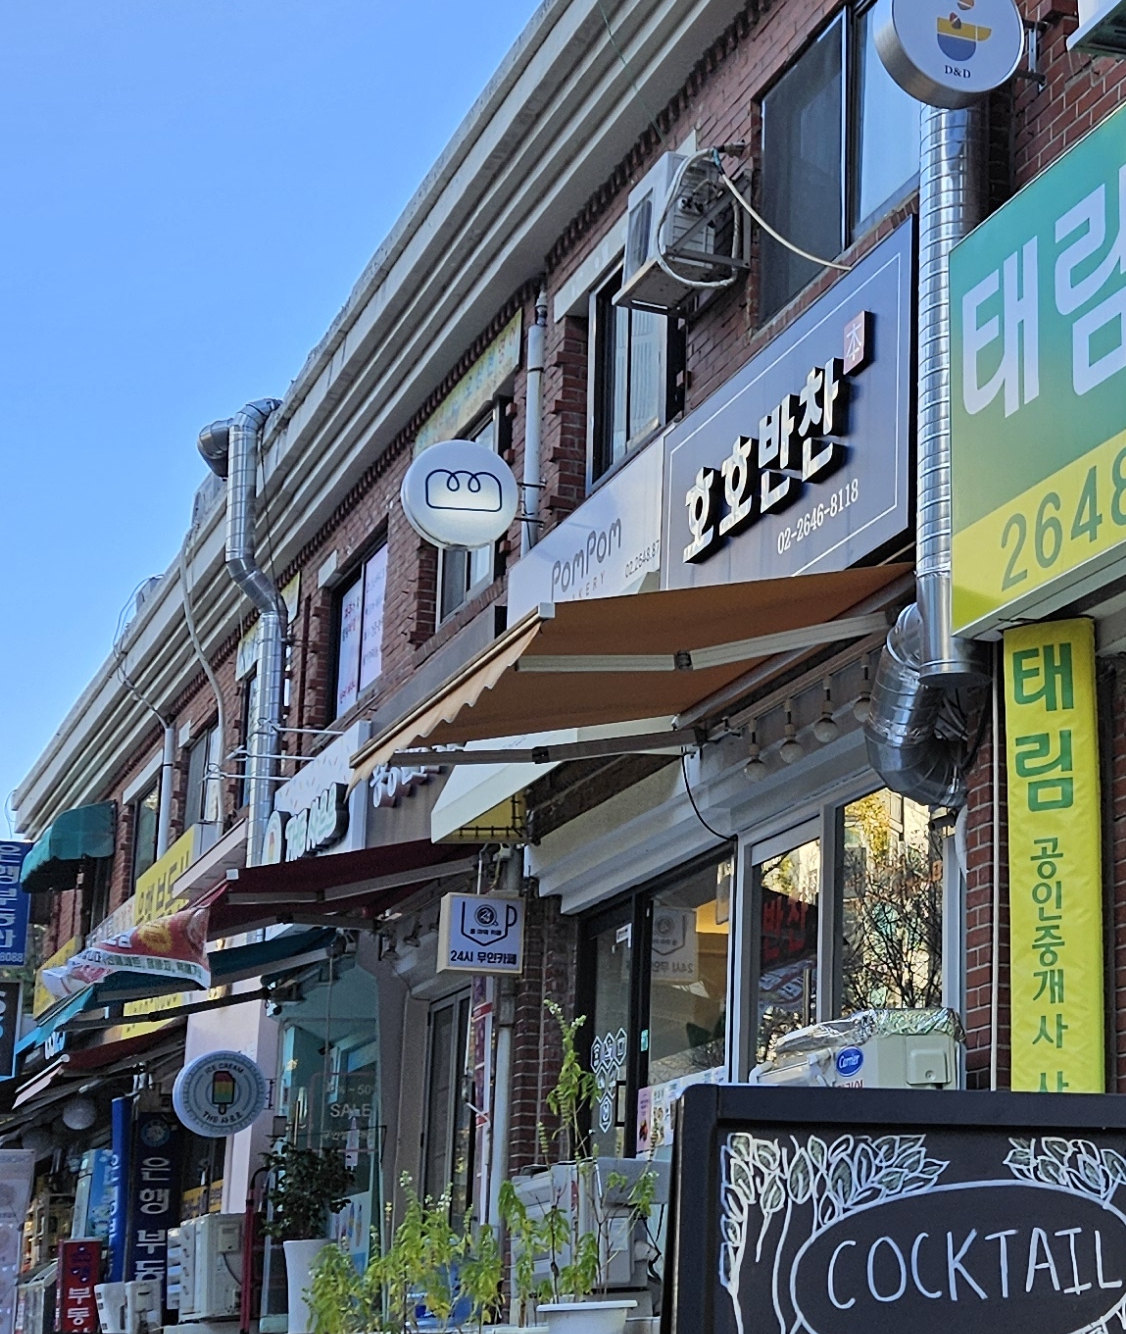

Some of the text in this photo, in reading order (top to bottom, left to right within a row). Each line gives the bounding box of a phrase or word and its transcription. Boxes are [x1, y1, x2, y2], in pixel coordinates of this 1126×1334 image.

[944, 65, 971, 79] D&D
[682, 357, 841, 564] 호호반찬
[777, 478, 860, 554] 02-2646-8118
[1011, 641, 1075, 813] 태림
[450, 950, 517, 965] 24시 무인카페
[1029, 837, 1069, 1050] 공인중개사
[329, 1103, 372, 1118] SALE
[138, 1156, 171, 1215] 은행
[828, 1225, 1124, 1307] COCKTAIL
